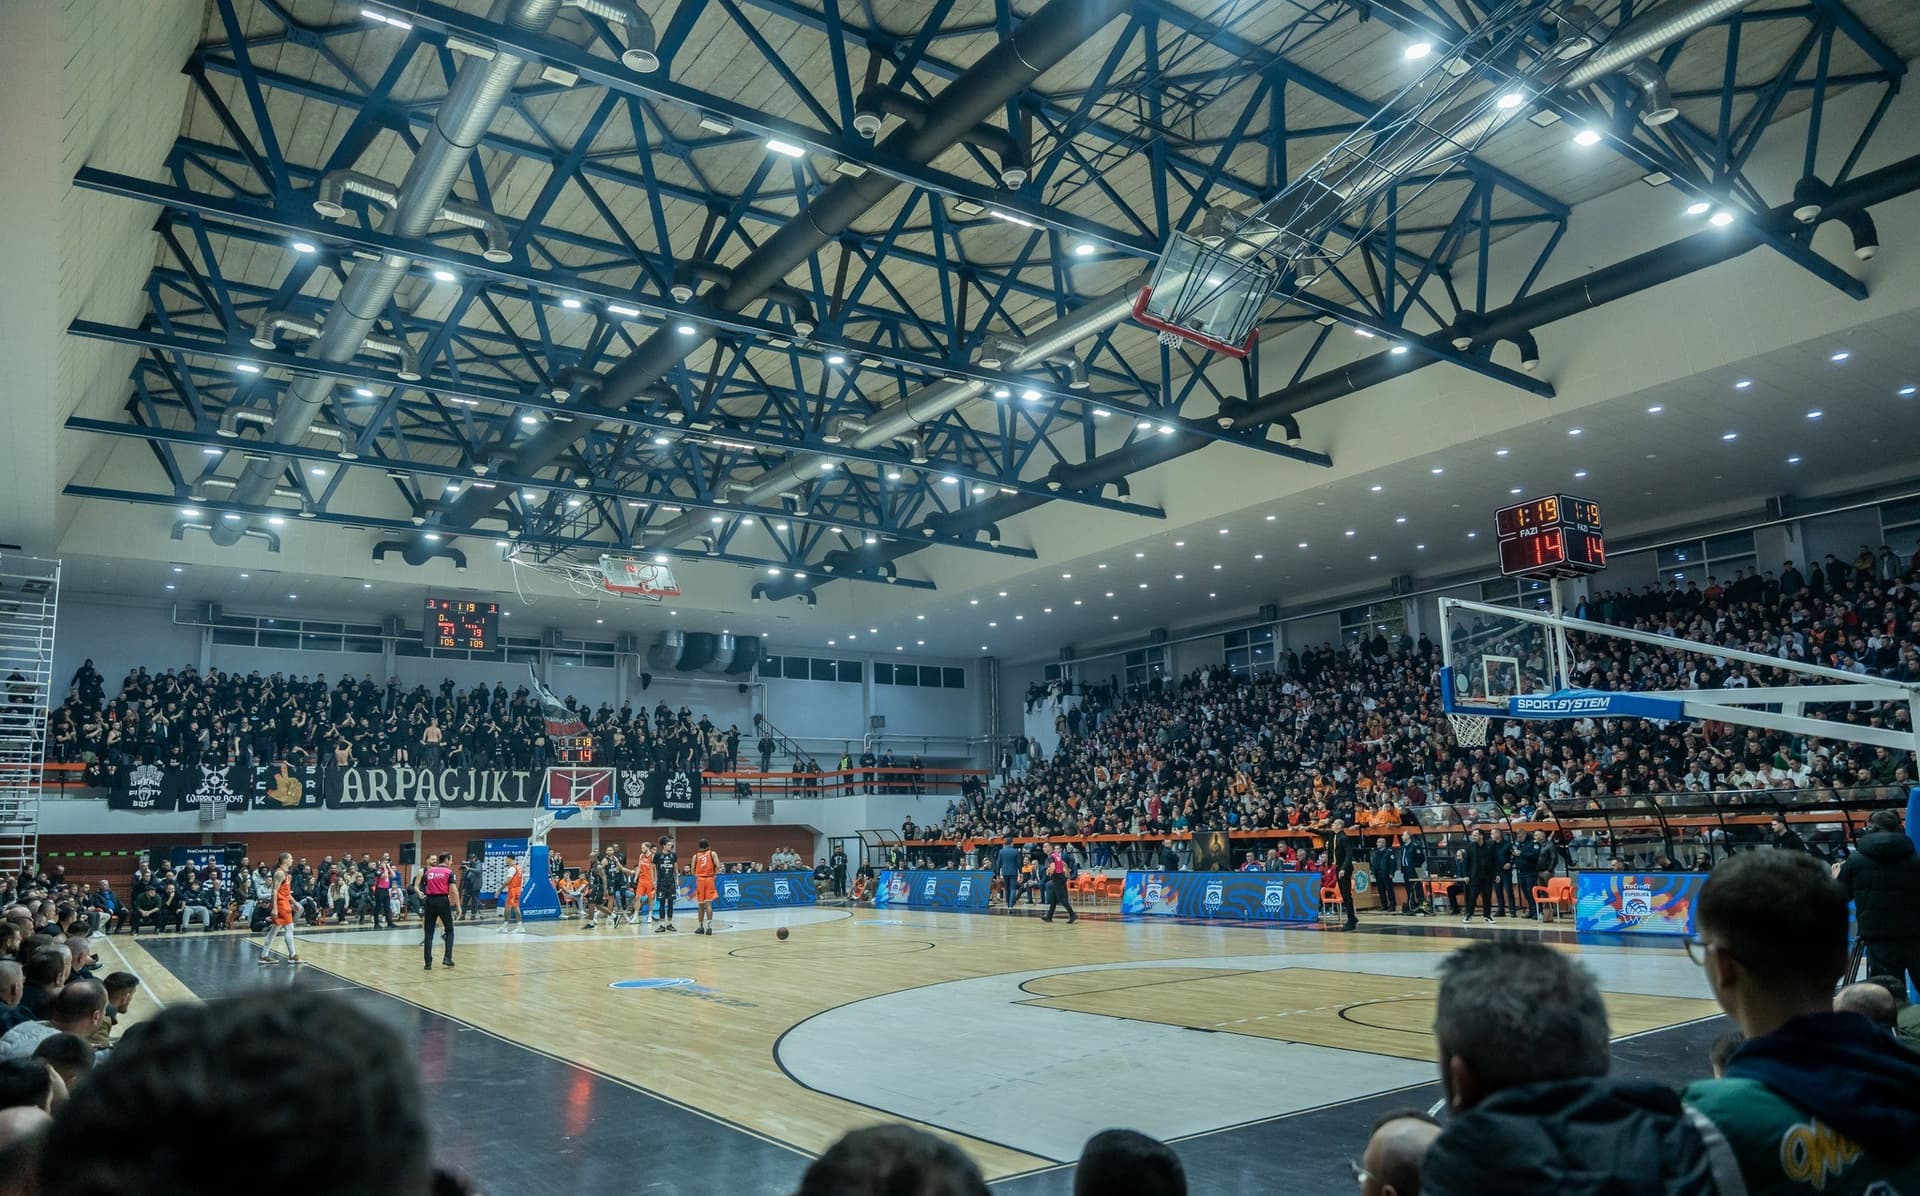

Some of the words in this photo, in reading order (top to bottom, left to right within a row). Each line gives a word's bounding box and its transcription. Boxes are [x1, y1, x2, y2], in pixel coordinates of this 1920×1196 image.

[1518, 499, 1557, 526] 1:19
[1574, 501, 1599, 525] 1:19
[1520, 527, 1538, 537] FAZI
[1577, 523, 1589, 533] FAZI
[1536, 532, 1563, 564] 14
[1586, 535, 1605, 564] 14
[440, 638, 454, 647] 105
[469, 640, 484, 648] 109
[1517, 697, 1610, 712] SPORTSYSTEM
[580, 750, 592, 761] 14
[340, 766, 530, 802] ARPAGJIKT
